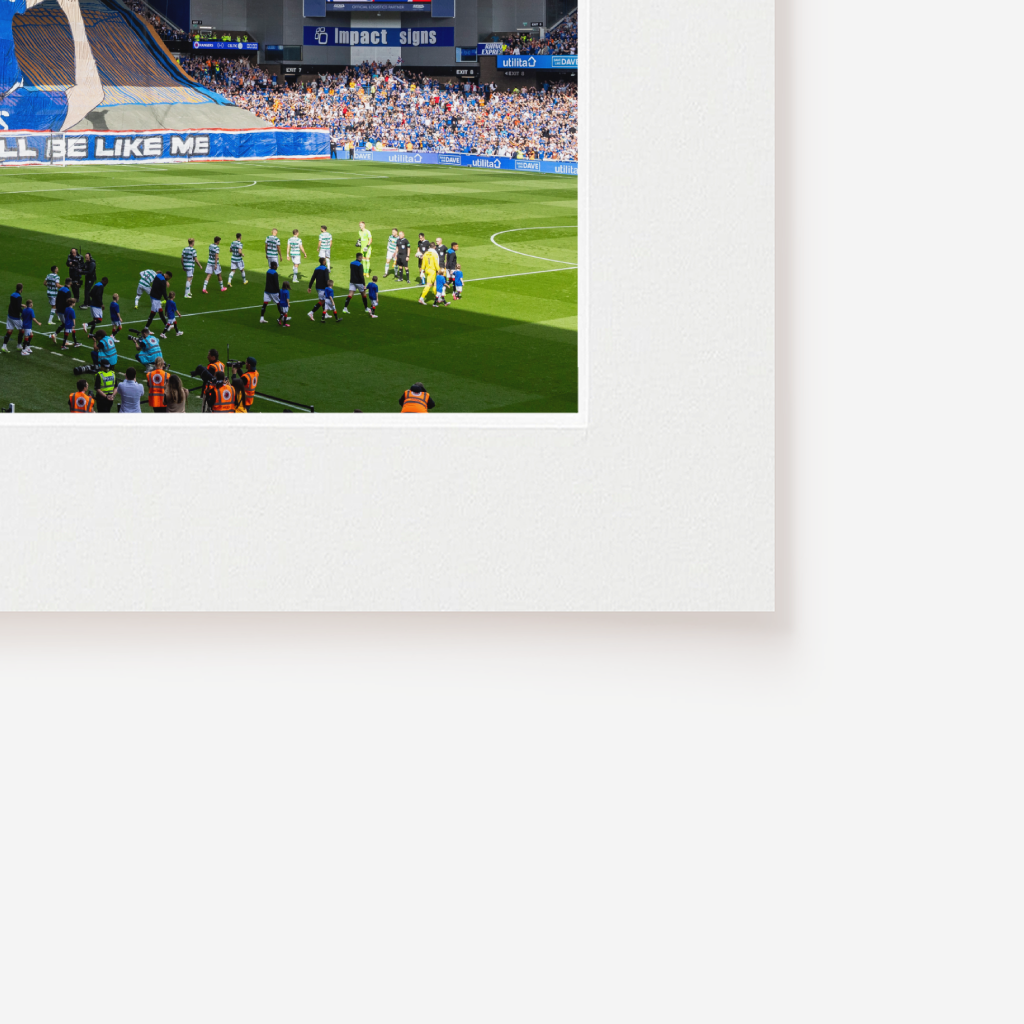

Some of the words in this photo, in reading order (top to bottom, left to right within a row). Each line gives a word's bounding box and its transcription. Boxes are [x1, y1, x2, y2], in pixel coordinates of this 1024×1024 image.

[334, 27, 388, 46] Impact
[399, 28, 437, 47] signs
[502, 57, 528, 67] utilita
[47, 137, 87, 159] BE
[95, 136, 164, 158] LIKE
[171, 136, 210, 157] ME
[388, 154, 414, 163] utilita
[445, 156, 460, 164] DAVE
[472, 158, 494, 168] utilita
[523, 162, 539, 170] DAVE
[554, 165, 578, 175] utilita
